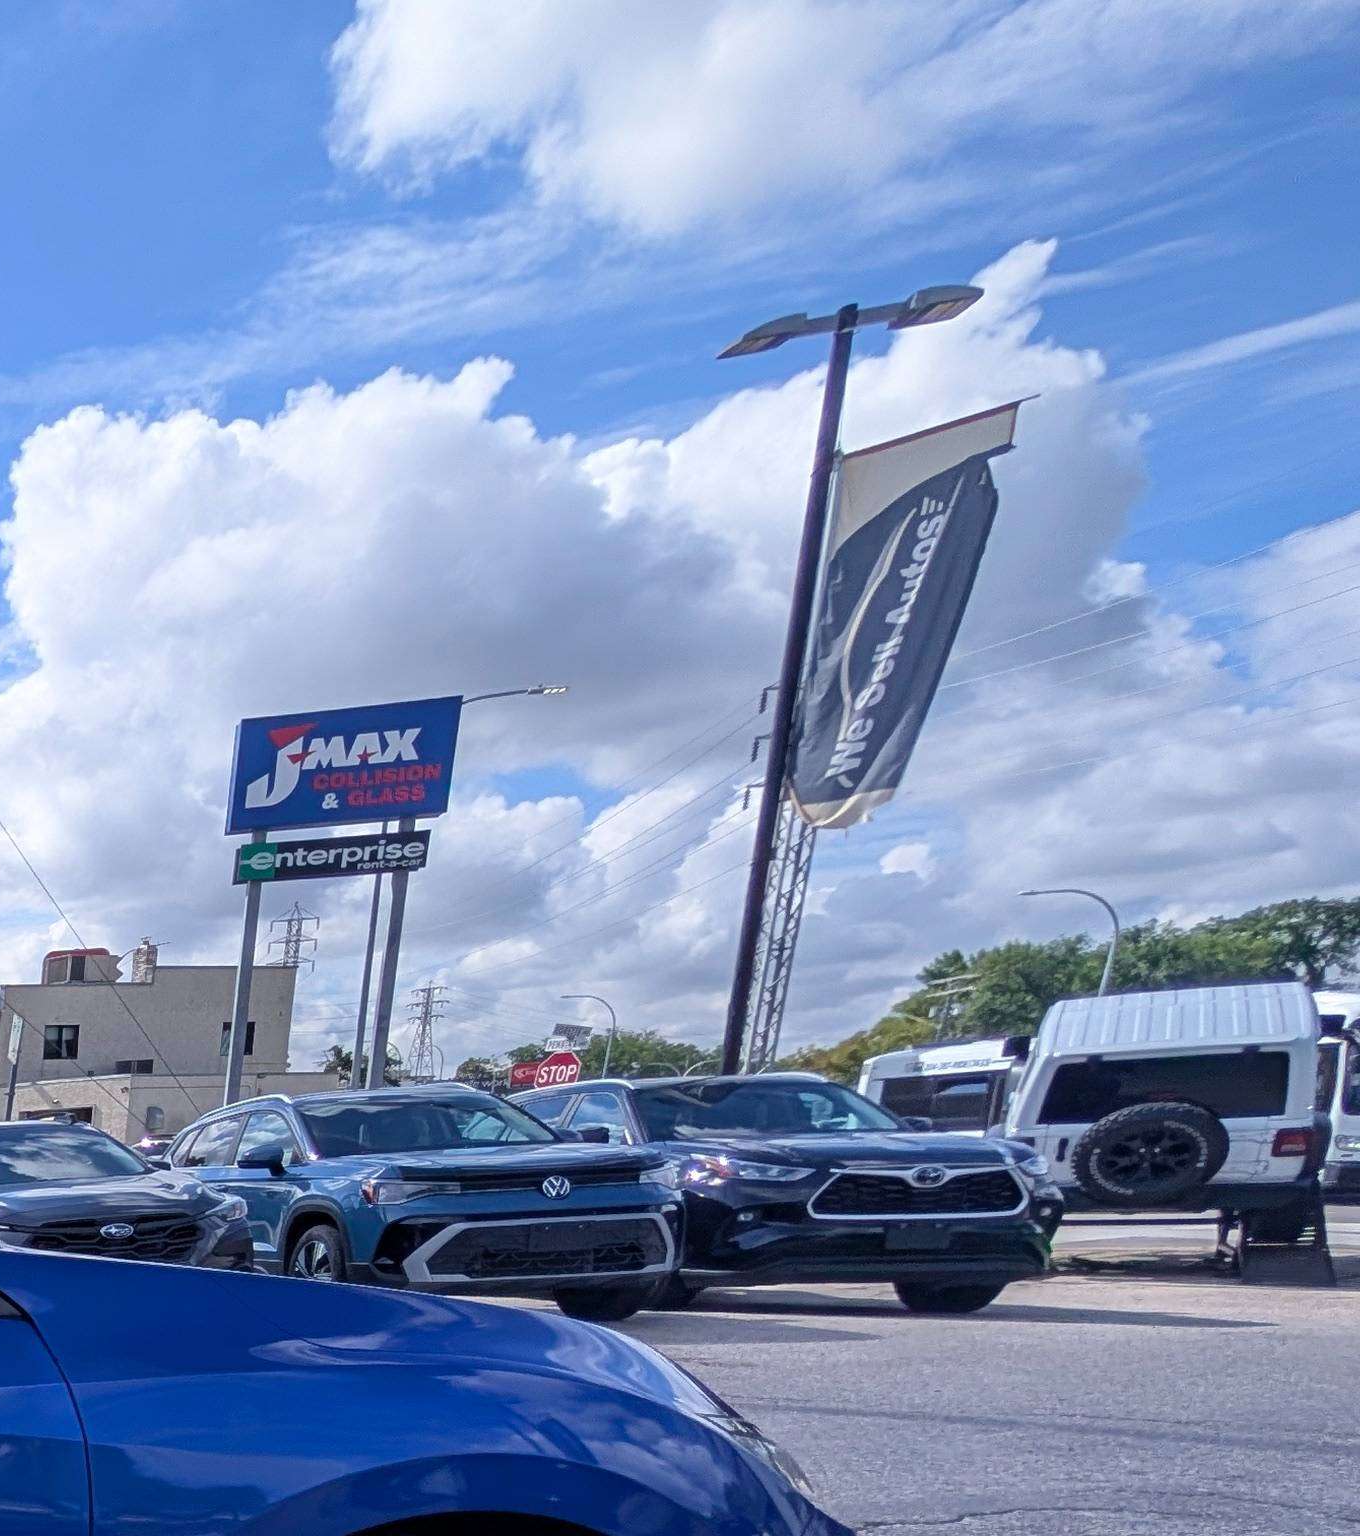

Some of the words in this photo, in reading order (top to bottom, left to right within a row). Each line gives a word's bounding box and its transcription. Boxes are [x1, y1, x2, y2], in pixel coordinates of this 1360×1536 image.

[824, 716, 875, 778] We
[854, 636, 904, 711] Sell
[885, 513, 946, 624] Autos
[312, 764, 442, 790] COLLISION
[322, 793, 339, 809] &
[347, 784, 426, 806] GLASS
[249, 840, 425, 870] enterprise
[357, 857, 423, 871] rent-a-car
[538, 1064, 577, 1083] STOP
